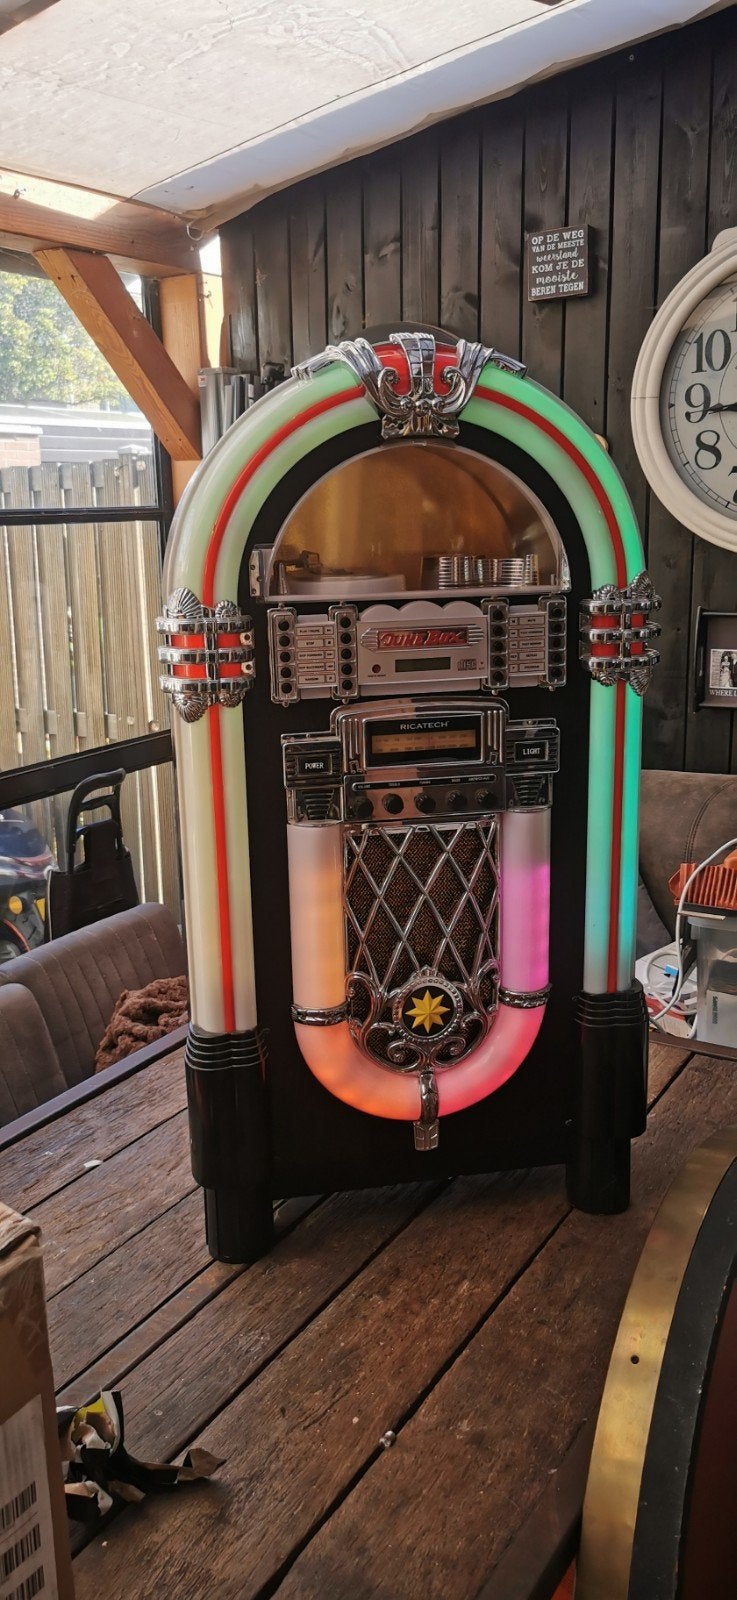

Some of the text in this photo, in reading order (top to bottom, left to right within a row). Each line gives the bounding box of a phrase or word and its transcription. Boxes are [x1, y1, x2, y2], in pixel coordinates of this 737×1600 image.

[532, 230, 584, 245] OP DE WEG
[558, 239, 584, 249] MEESTE
[532, 259, 584, 273] KOM JE DE
[536, 270, 578, 285] mooiste
[531, 281, 584, 296] BEREN TEGEN
[691, 328, 732, 374] 10
[684, 383, 711, 423] 9
[694, 429, 722, 470] 8
[709, 689, 733, 697] WHERE
[522, 747, 540, 755] LIGHT
